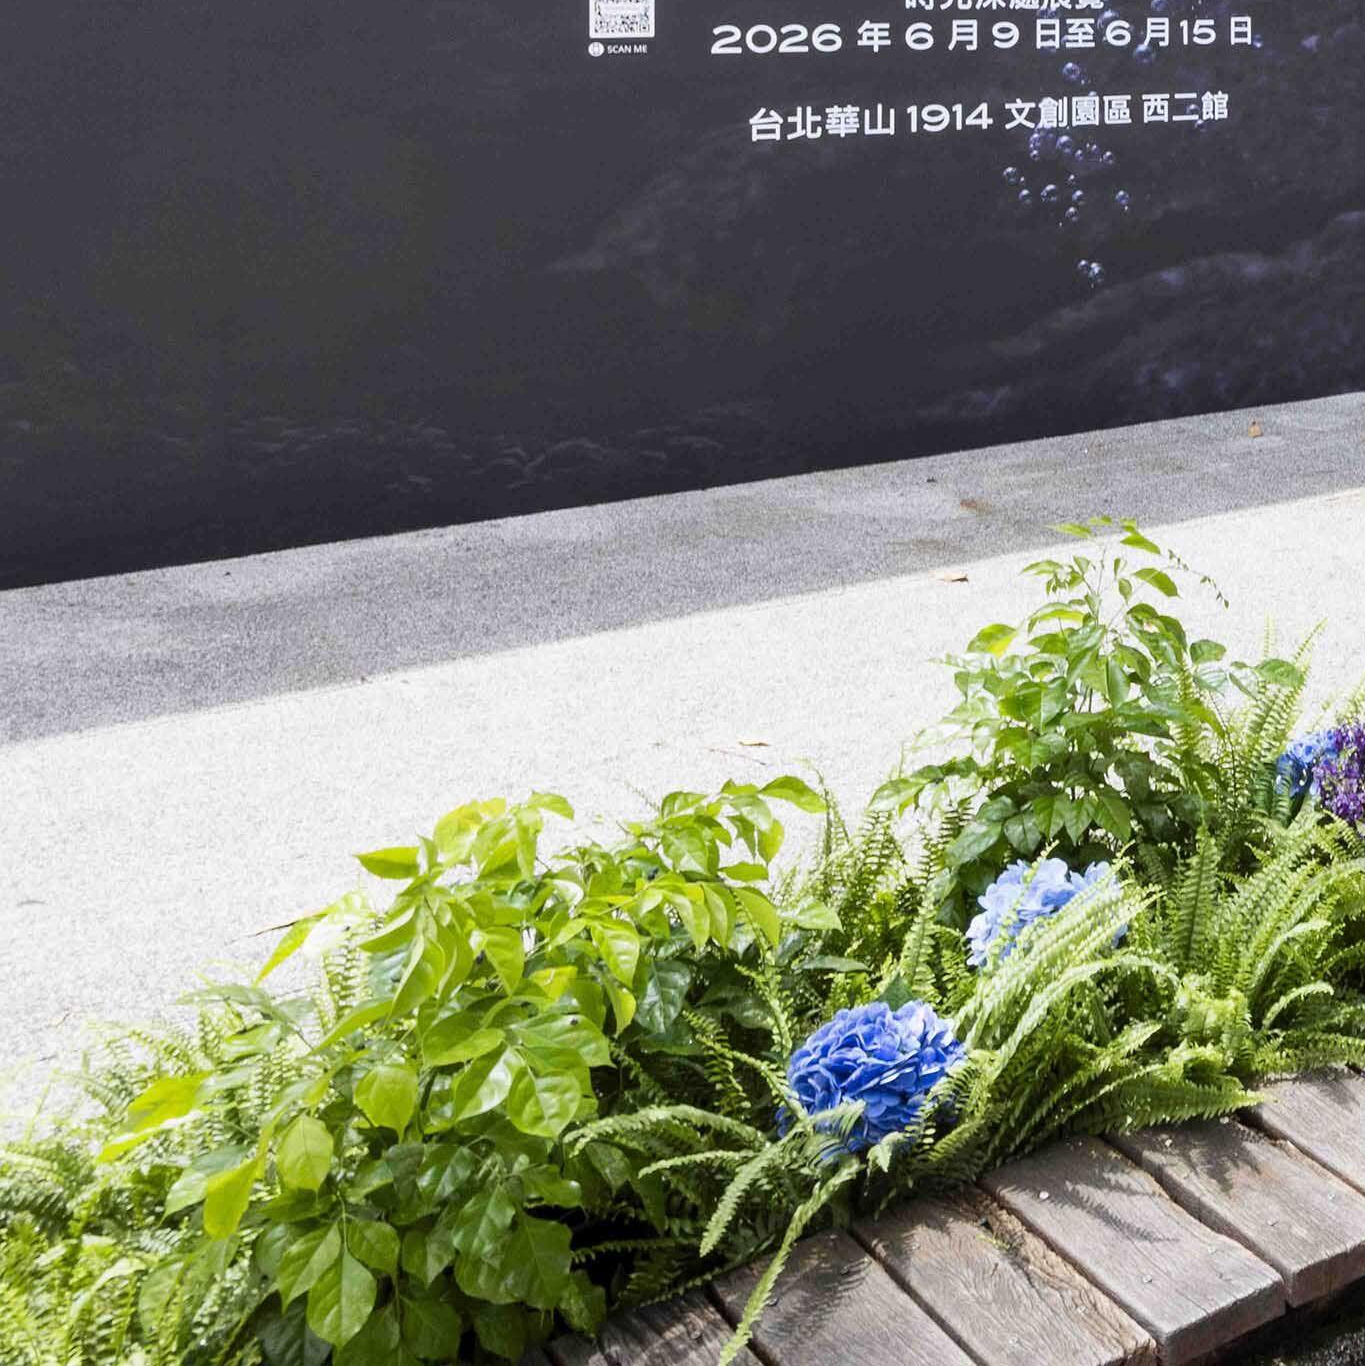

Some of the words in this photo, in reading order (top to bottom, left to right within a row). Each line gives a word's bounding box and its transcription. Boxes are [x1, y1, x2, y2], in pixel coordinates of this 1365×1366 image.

[606, 44, 632, 55] SCAN
[633, 44, 648, 54] ME
[710, 23, 843, 55] 2026
[856, 19, 892, 53] 年
[904, 21, 935, 51] 6
[948, 19, 979, 52] 月
[991, 21, 1020, 49] 9
[1035, 17, 1096, 50] 日至
[1105, 19, 1132, 47] 6
[1143, 17, 1170, 47] 月
[1179, 18, 1217, 46] 15
[1230, 15, 1252, 46] 日
[748, 102, 896, 142] 台北華山
[906, 102, 994, 133] 1914
[1004, 93, 1132, 130] 文創園區
[1141, 90, 1229, 124] 西二館
